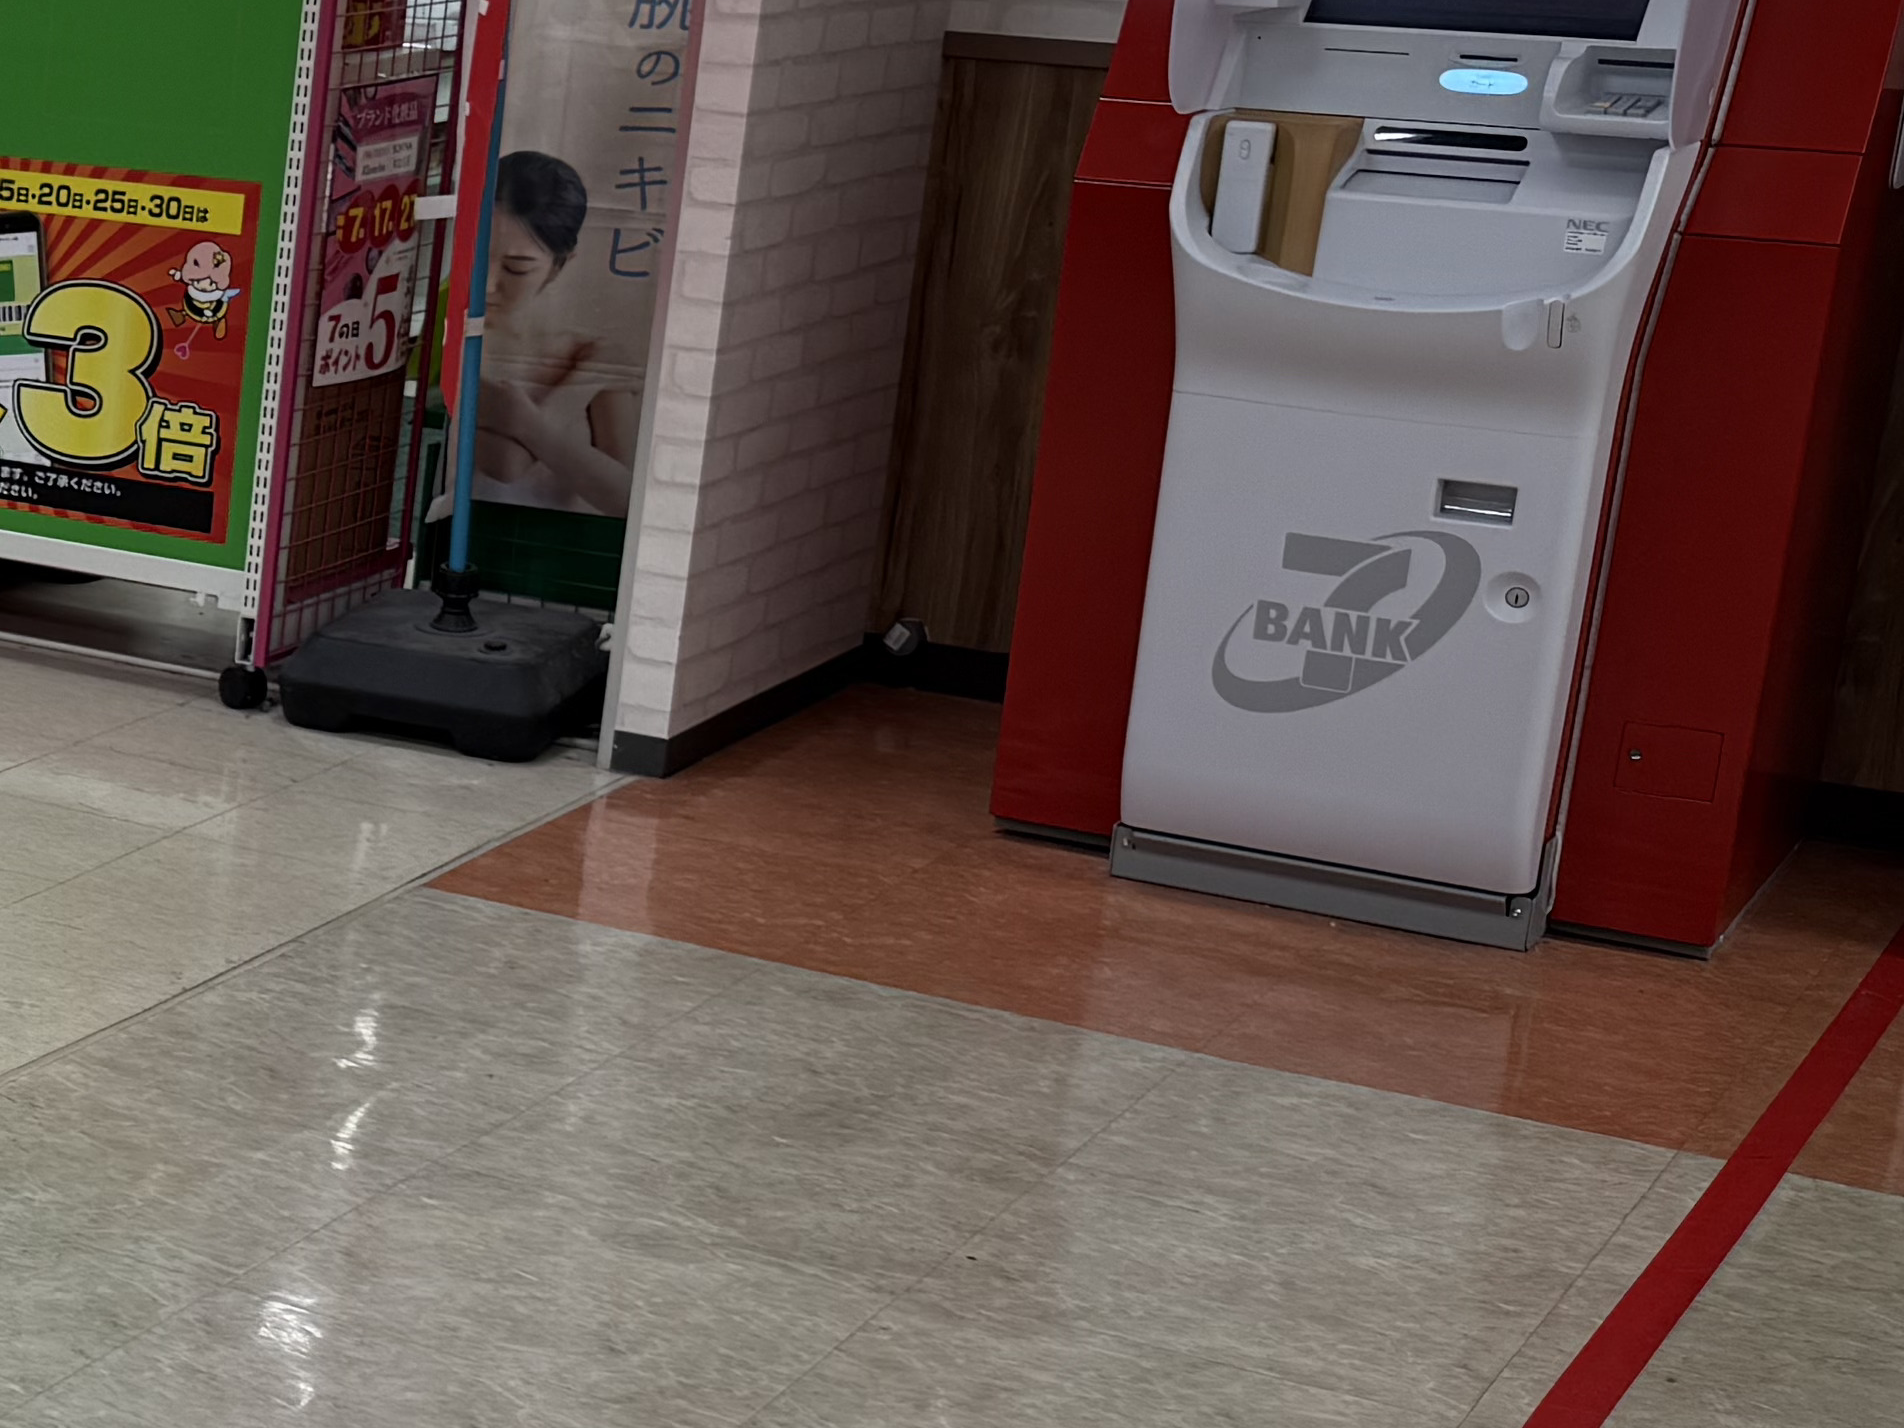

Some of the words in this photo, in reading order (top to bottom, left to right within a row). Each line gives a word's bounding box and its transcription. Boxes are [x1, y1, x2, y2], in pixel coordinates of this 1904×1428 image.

[1566, 219, 1610, 233] NEC
[327, 314, 360, 344] 7の日
[364, 272, 401, 370] 5
[13, 279, 160, 463] 3
[139, 404, 216, 481] 倍
[319, 344, 361, 375] ポイント
[1253, 598, 1420, 663] BANK
